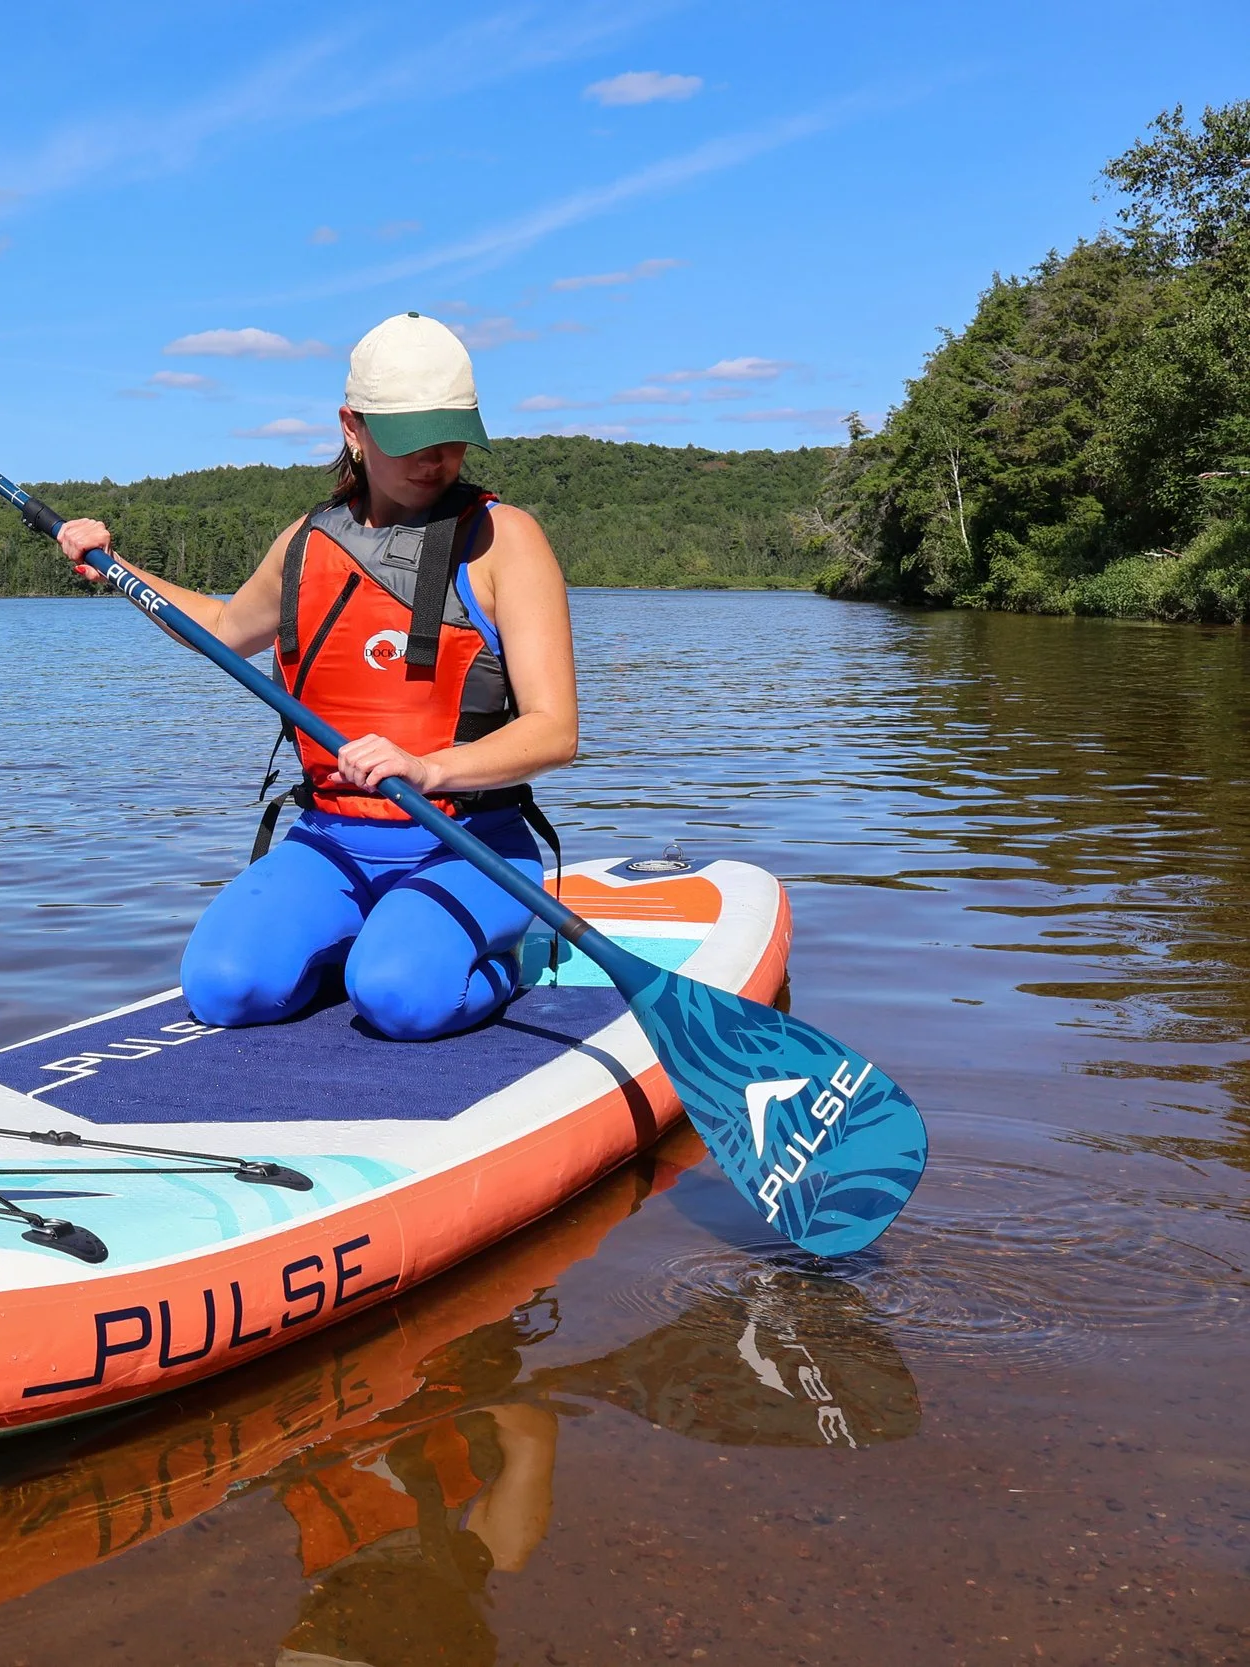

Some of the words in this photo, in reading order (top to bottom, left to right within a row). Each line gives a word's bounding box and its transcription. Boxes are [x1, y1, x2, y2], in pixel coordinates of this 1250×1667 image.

[106, 563, 169, 625] PULSE
[365, 648, 406, 658] DOCKST
[26, 1021, 226, 1098] PULS
[757, 1059, 874, 1224] PULSE
[21, 1233, 401, 1398] PULSE
